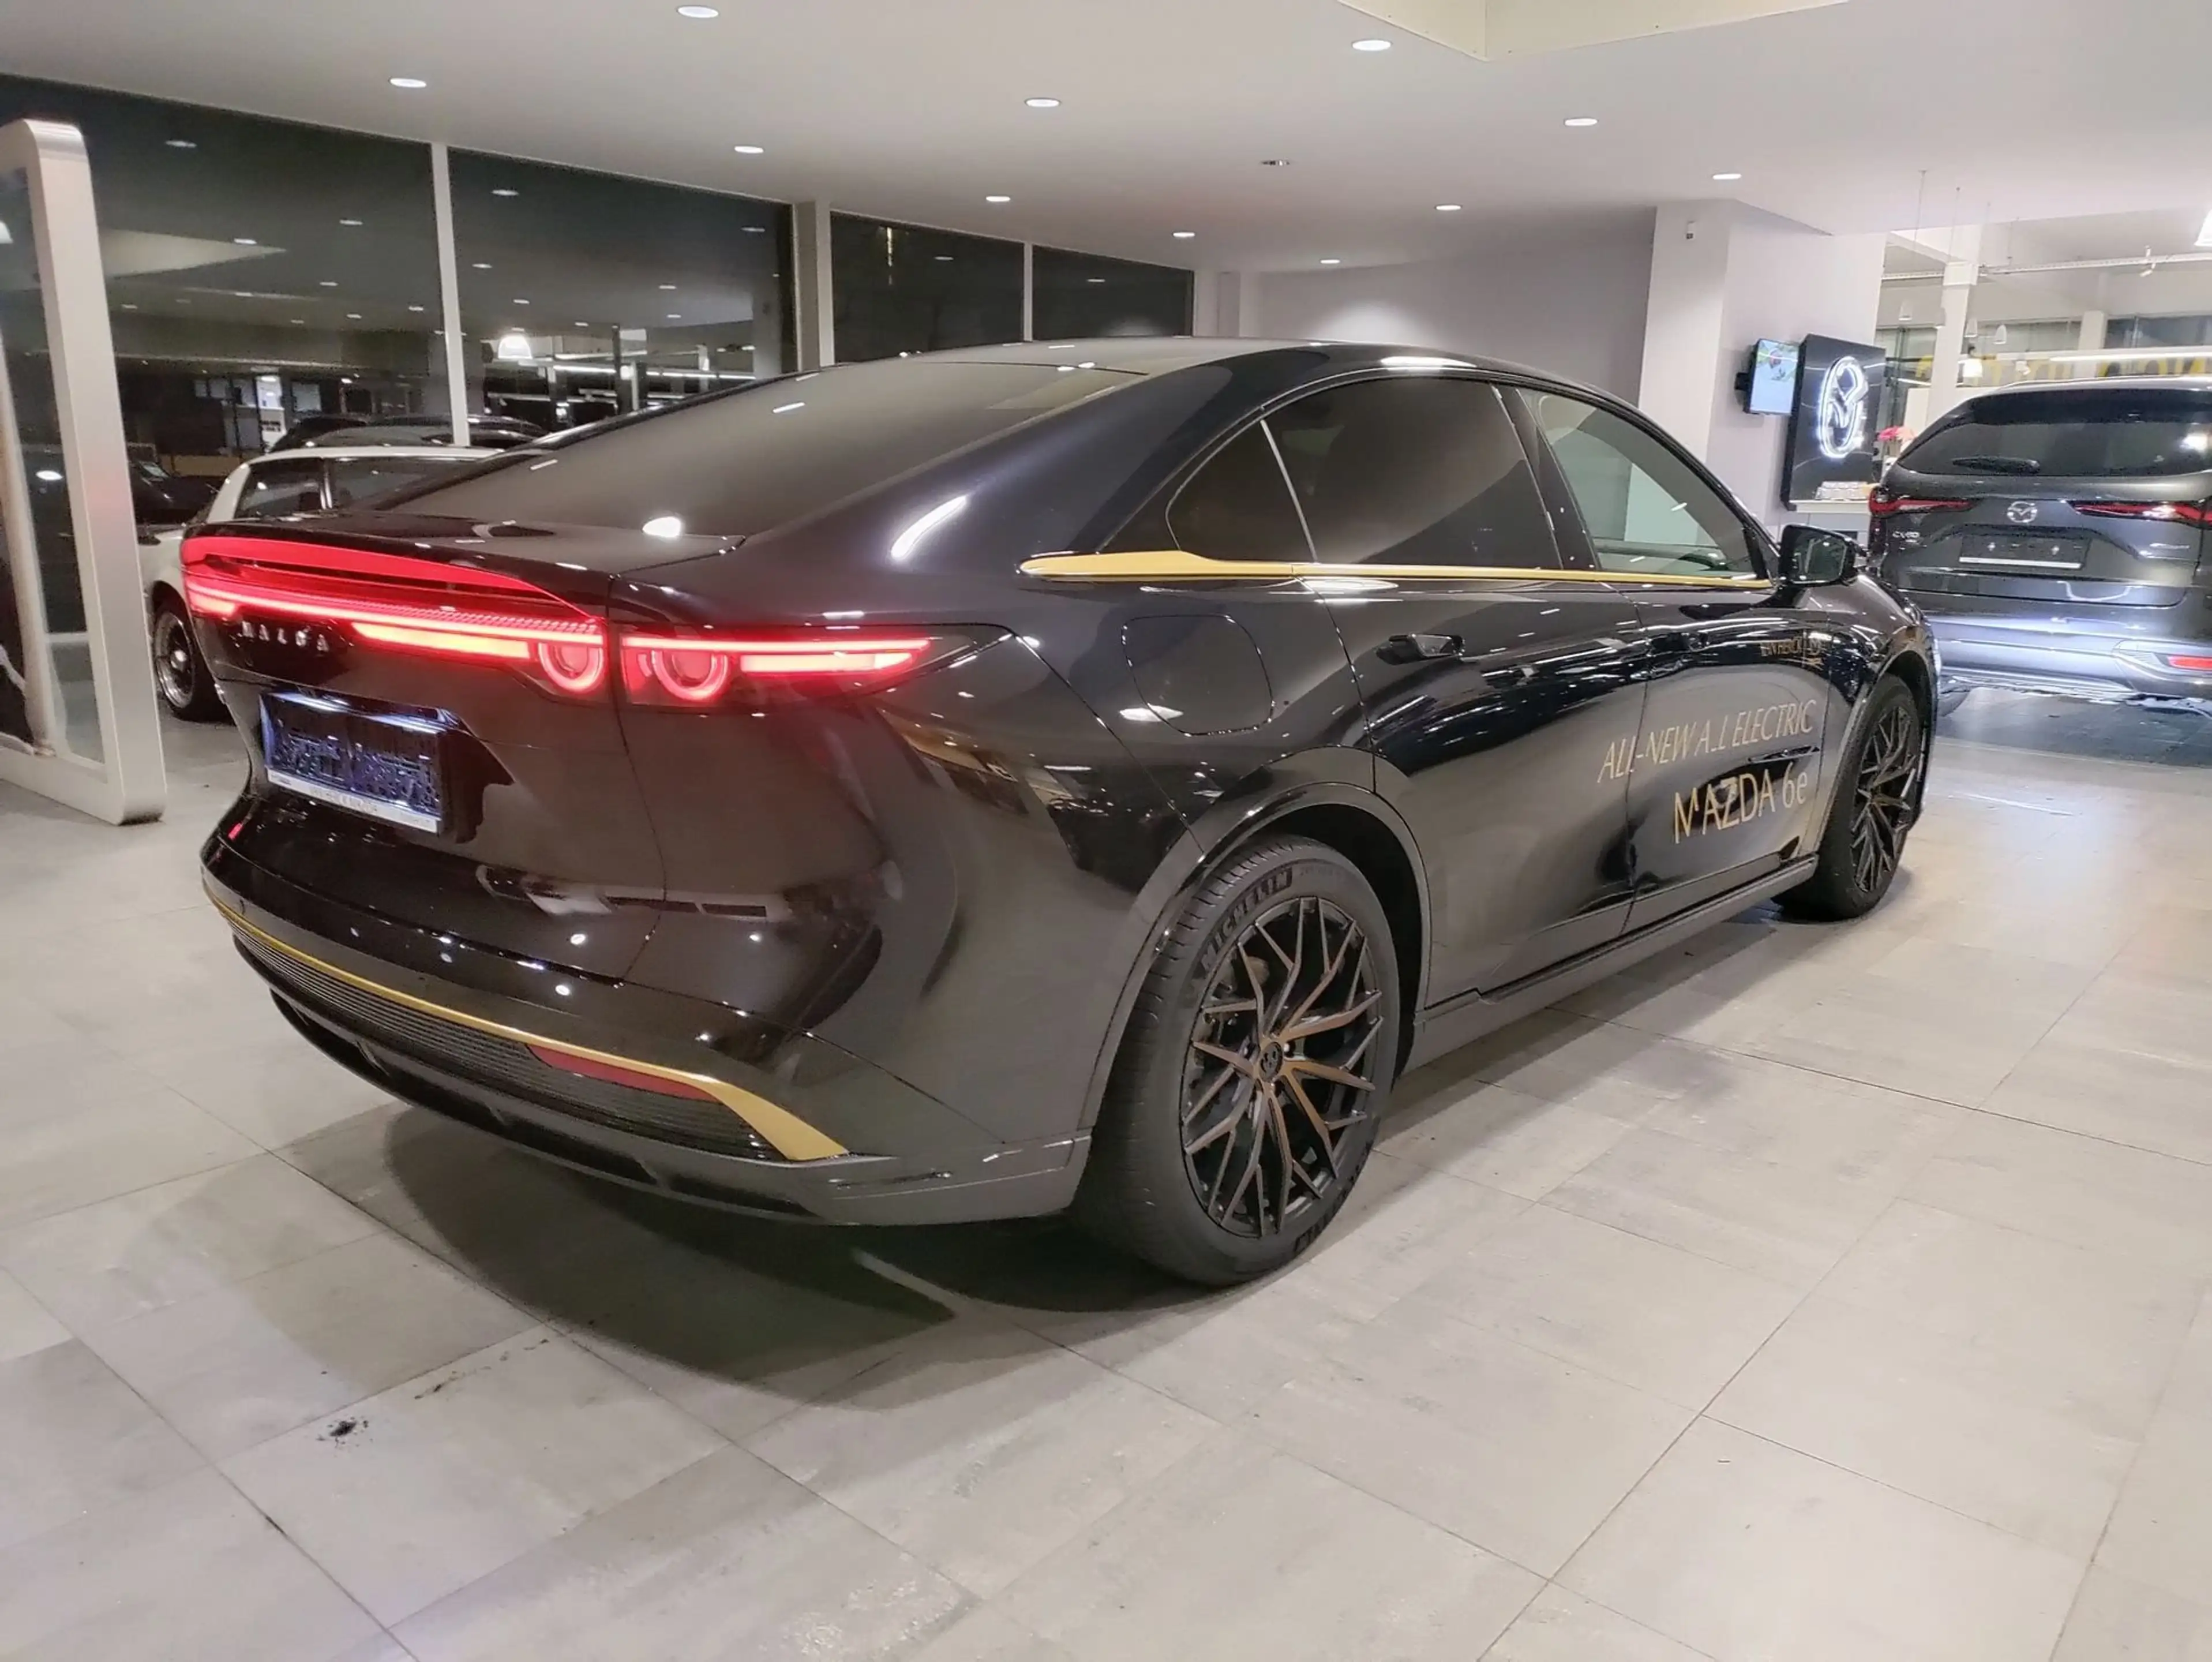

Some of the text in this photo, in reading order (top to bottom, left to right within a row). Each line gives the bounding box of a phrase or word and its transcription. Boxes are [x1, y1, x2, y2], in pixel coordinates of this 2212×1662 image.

[1597, 721, 1697, 783] ALL-NEW
[1732, 699, 1817, 747] ELECTRIC
[1674, 761, 1808, 844] MAZDA 6e
